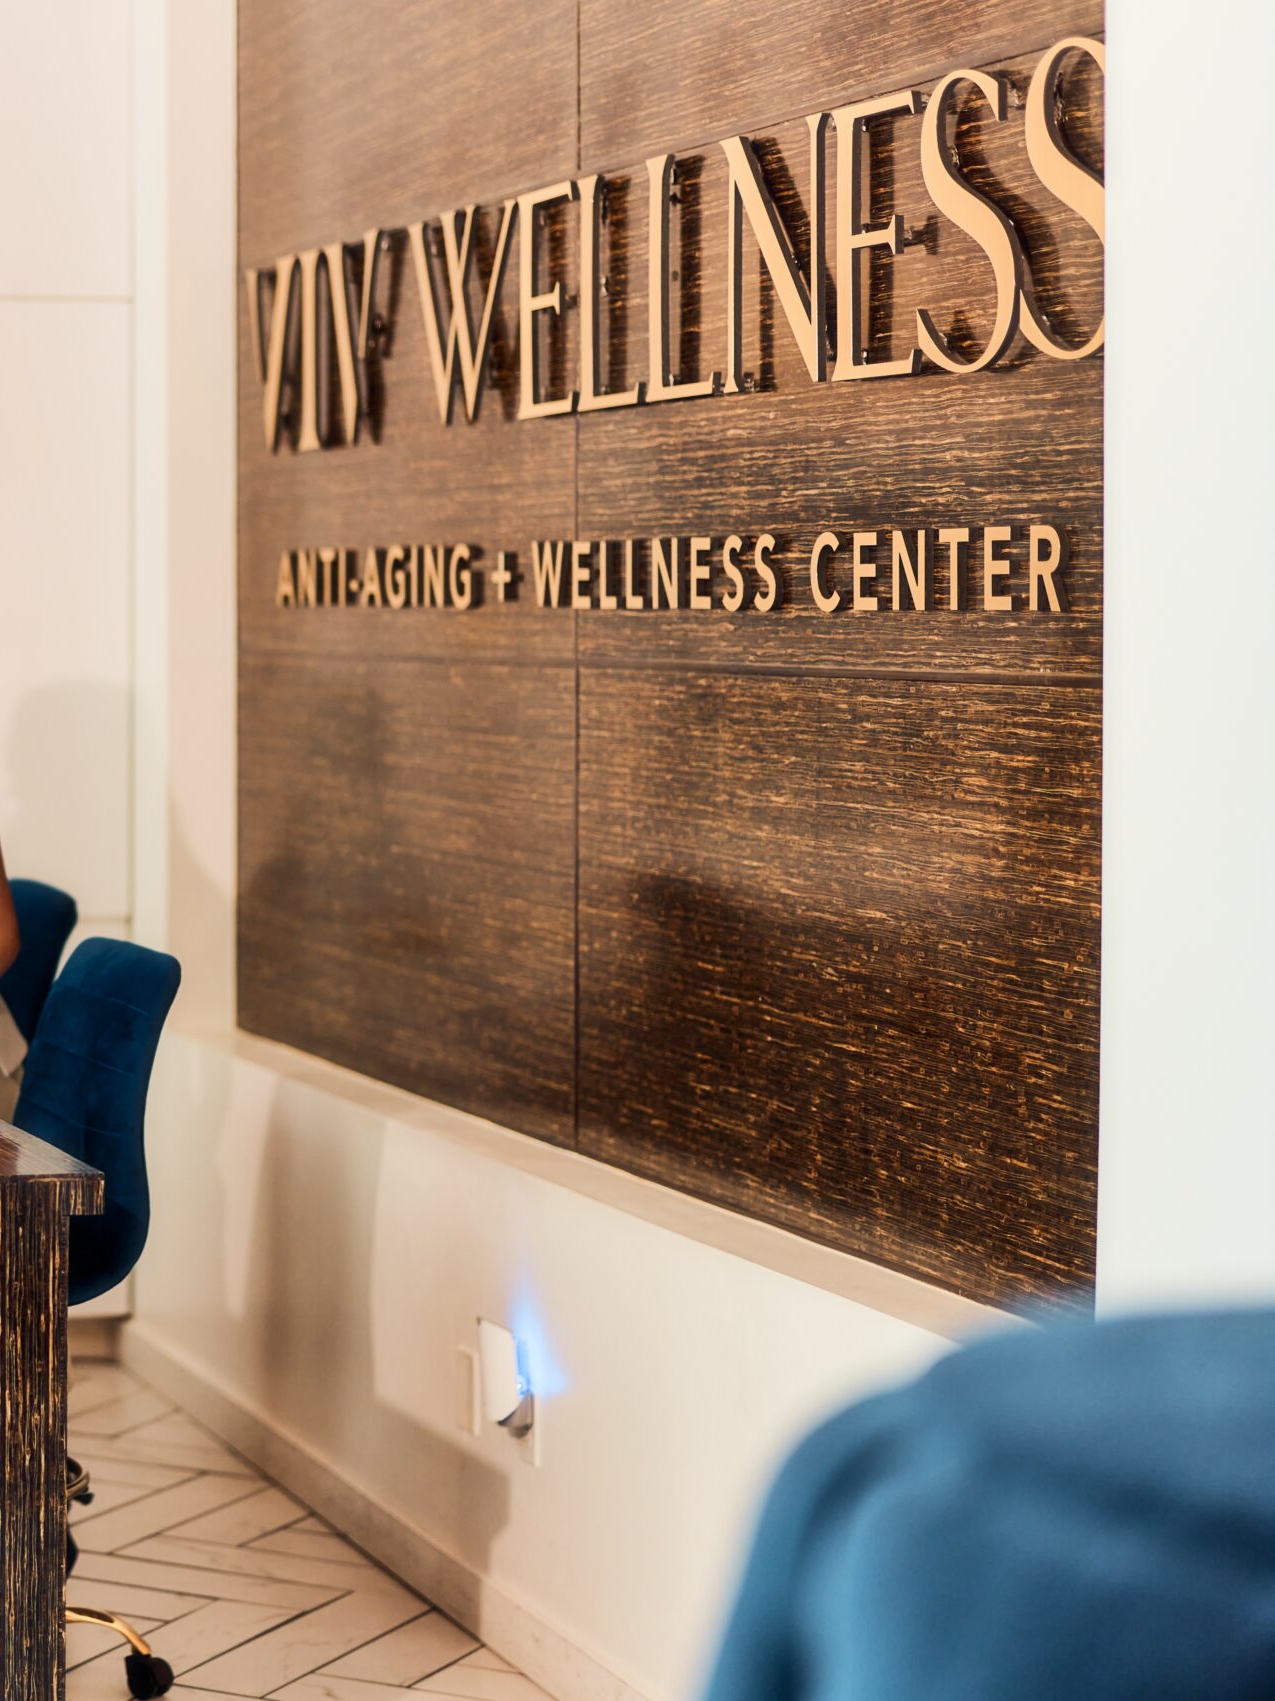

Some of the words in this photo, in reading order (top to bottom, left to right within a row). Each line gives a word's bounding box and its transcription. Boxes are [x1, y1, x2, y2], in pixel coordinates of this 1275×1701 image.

[245, 227, 379, 453] VIV
[407, 37, 1105, 424] WELLNESS
[276, 542, 473, 611] ANTI-AGING
[531, 533, 777, 612] WELLNESS
[810, 525, 1061, 612] CENTER
